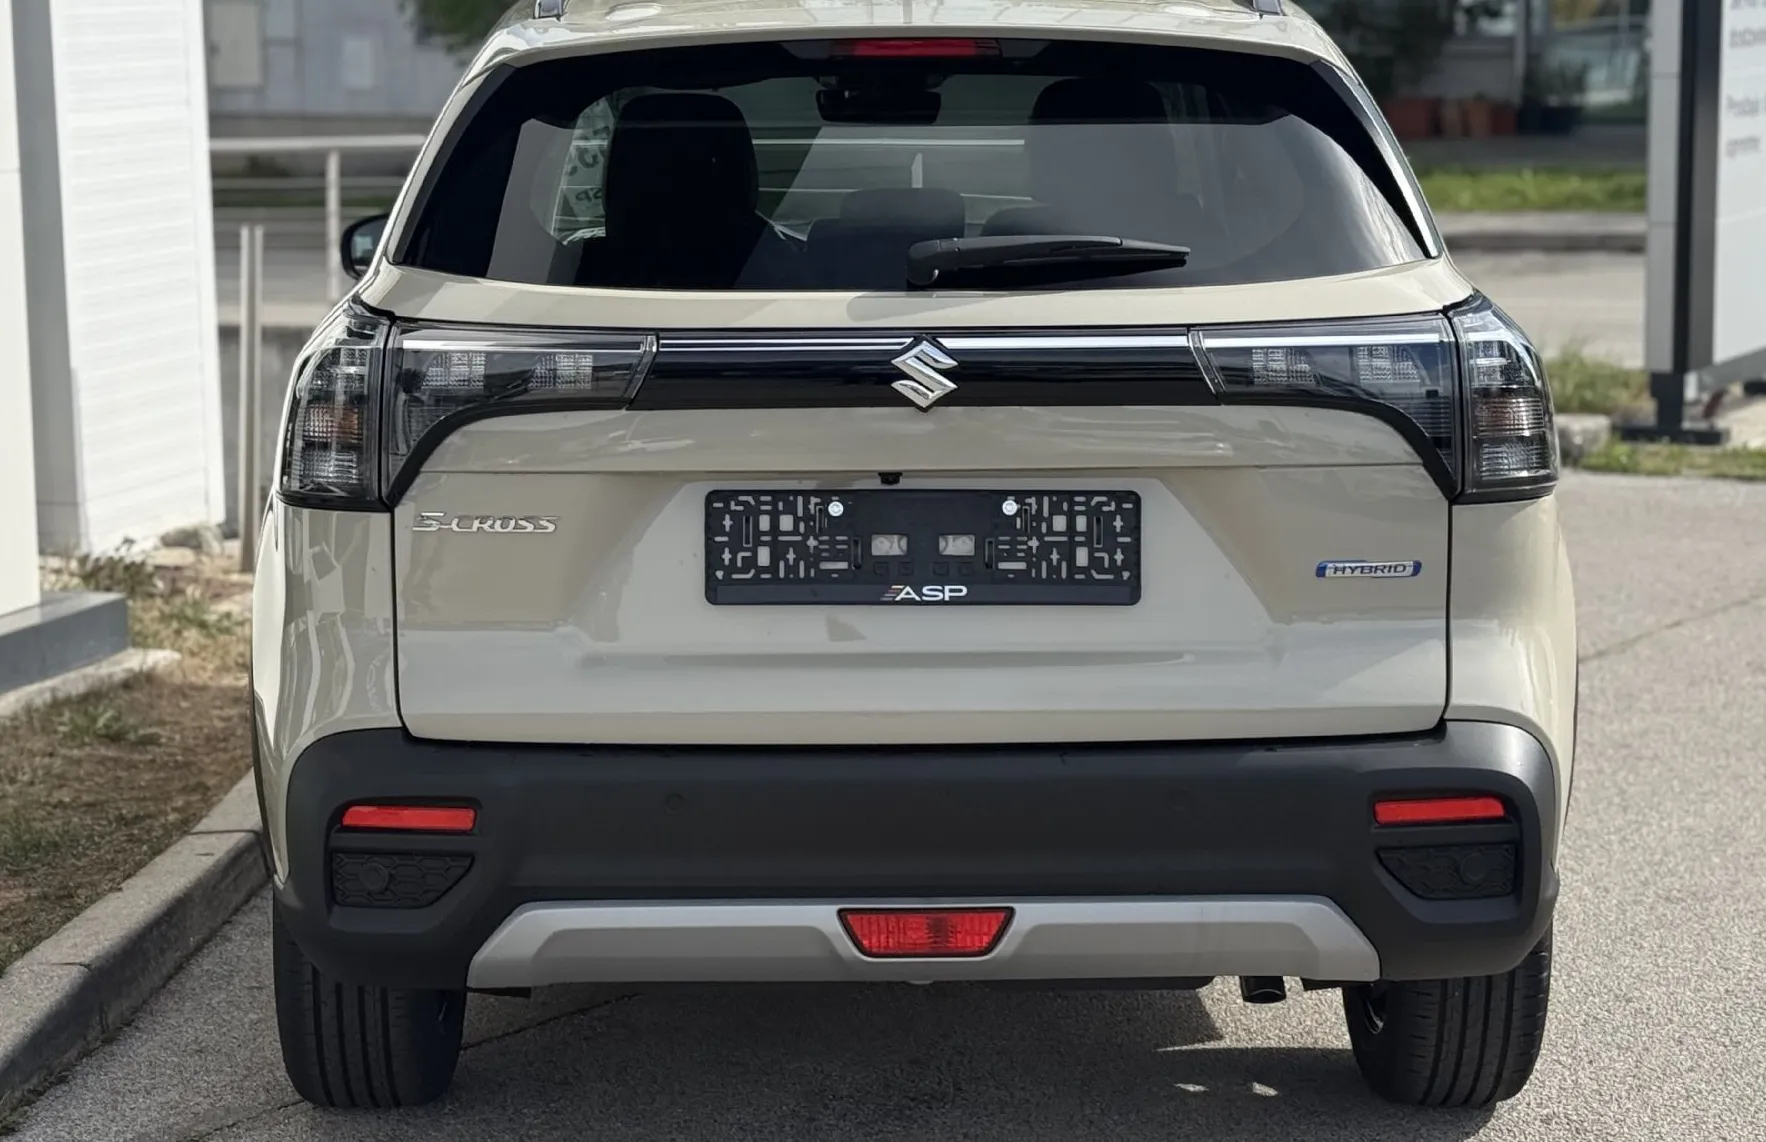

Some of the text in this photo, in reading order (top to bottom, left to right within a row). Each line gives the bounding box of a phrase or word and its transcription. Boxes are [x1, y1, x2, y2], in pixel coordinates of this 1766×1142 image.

[412, 512, 559, 533] S-CROSS
[1332, 563, 1407, 575] HYBRID
[894, 585, 968, 601] ASP
